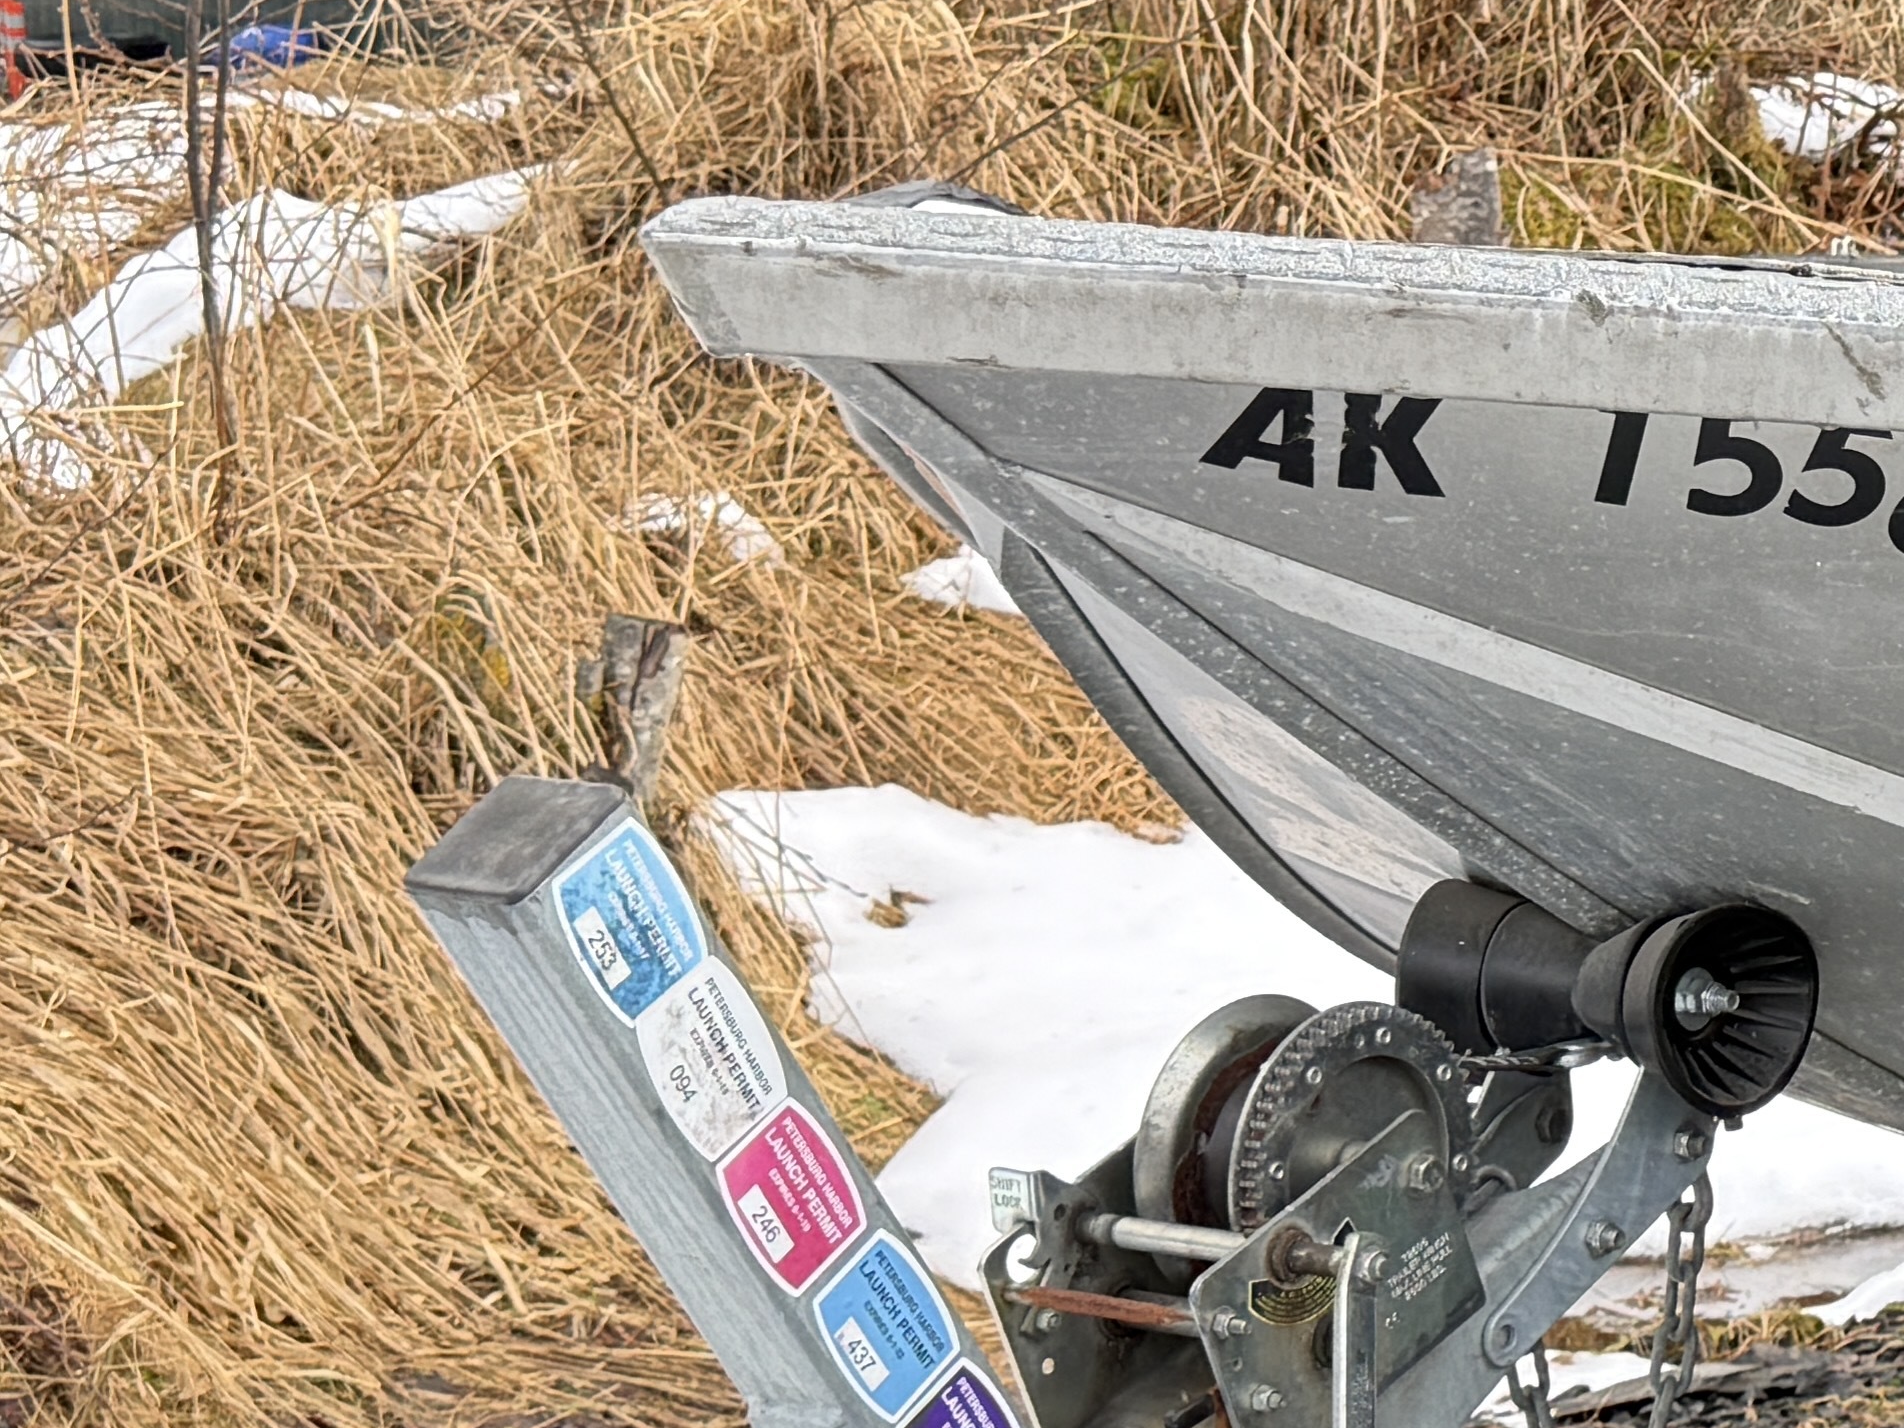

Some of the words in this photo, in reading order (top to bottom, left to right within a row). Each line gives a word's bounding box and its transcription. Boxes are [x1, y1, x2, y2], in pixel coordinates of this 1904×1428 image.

[1198, 386, 1446, 498] AK
[585, 927, 620, 973] 253
[668, 1062, 698, 1104] 094
[686, 986, 728, 1054] LAUNCH
[721, 1051, 761, 1111] PERMIT
[703, 976, 749, 1050] PETERSBURG
[742, 1047, 773, 1096] HARBOR
[750, 1203, 782, 1244] 246
[763, 1126, 808, 1191] LAUNCH
[801, 1186, 843, 1245] PERMIT
[780, 1115, 827, 1186] PETERSBURG
[821, 1183, 854, 1228] HARBOR
[990, 1176, 1021, 1193] SHIFT
[994, 1193, 1021, 1209] LOCK
[857, 1258, 902, 1320] LAUNCH
[895, 1317, 936, 1370] PERMIT
[874, 1248, 919, 1314] PETERSBURG
[913, 1311, 945, 1353] HARBOR
[844, 1335, 877, 1373] 437
